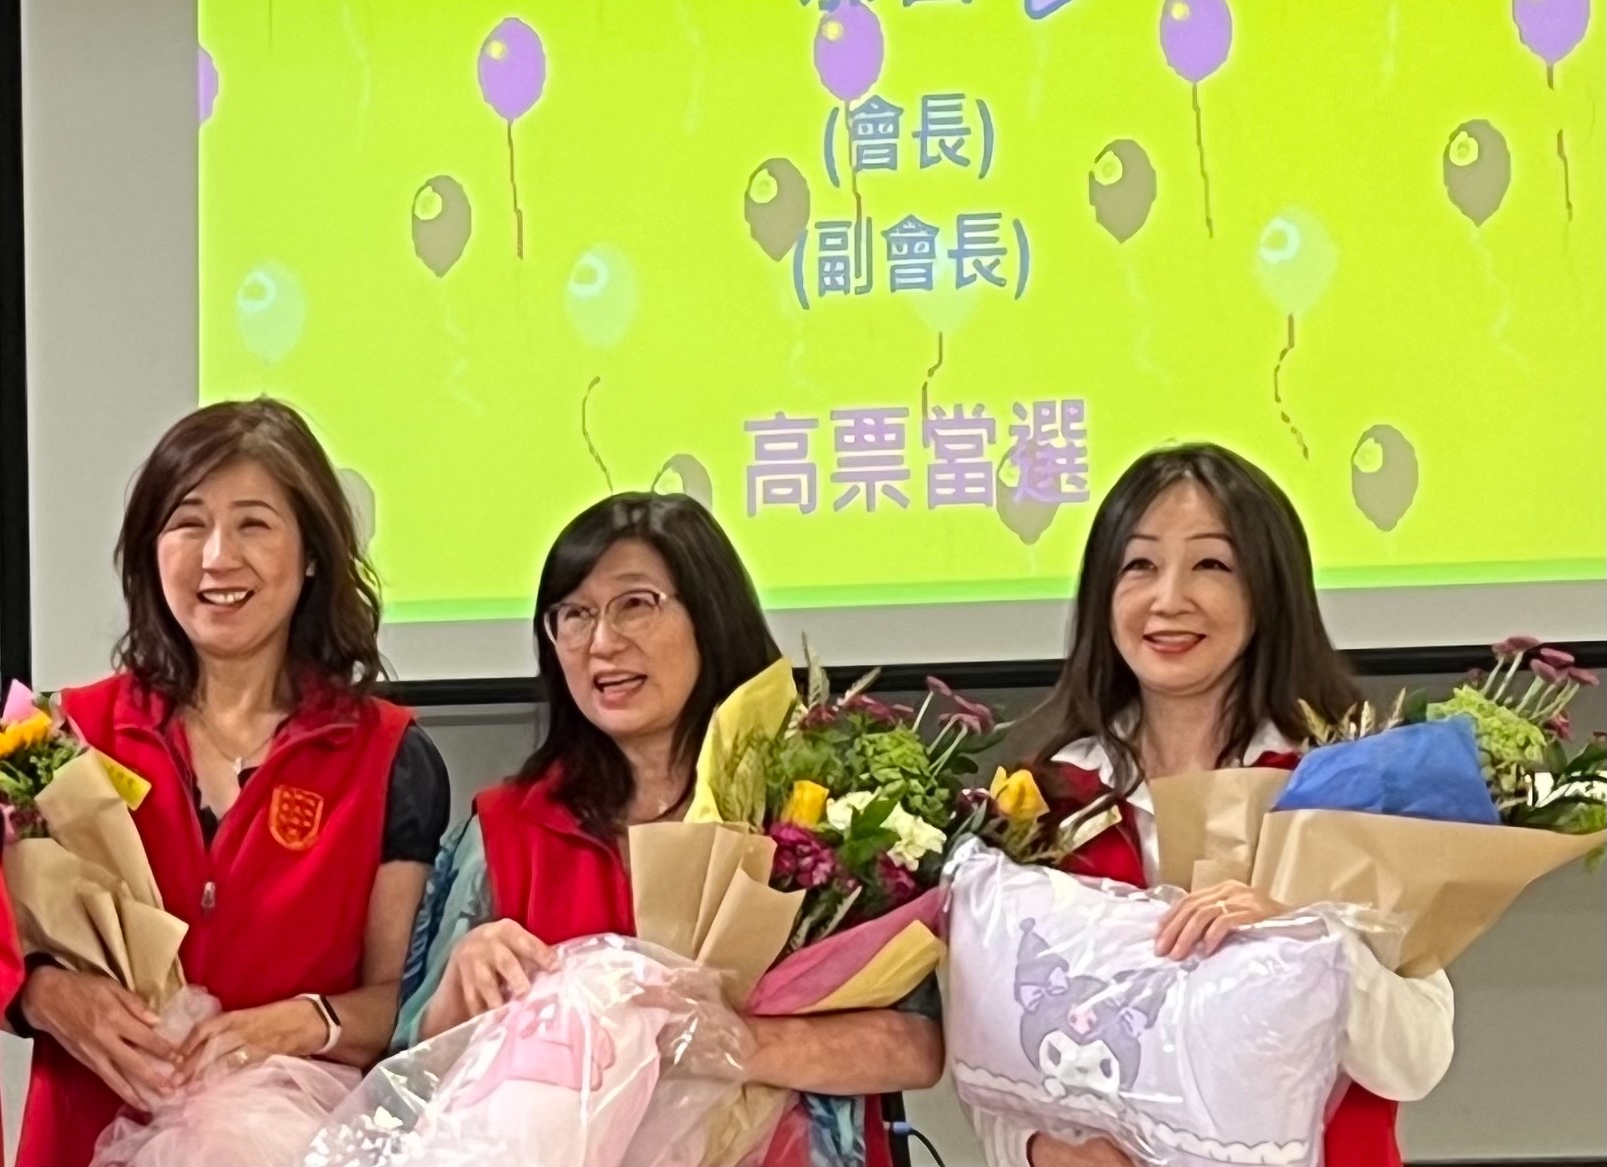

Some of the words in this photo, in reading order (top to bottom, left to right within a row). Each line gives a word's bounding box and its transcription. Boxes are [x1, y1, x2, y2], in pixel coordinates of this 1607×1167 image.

[823, 93, 994, 188] (會長)
[792, 212, 1030, 310] (副會長)
[743, 399, 1091, 518] 高票當選
